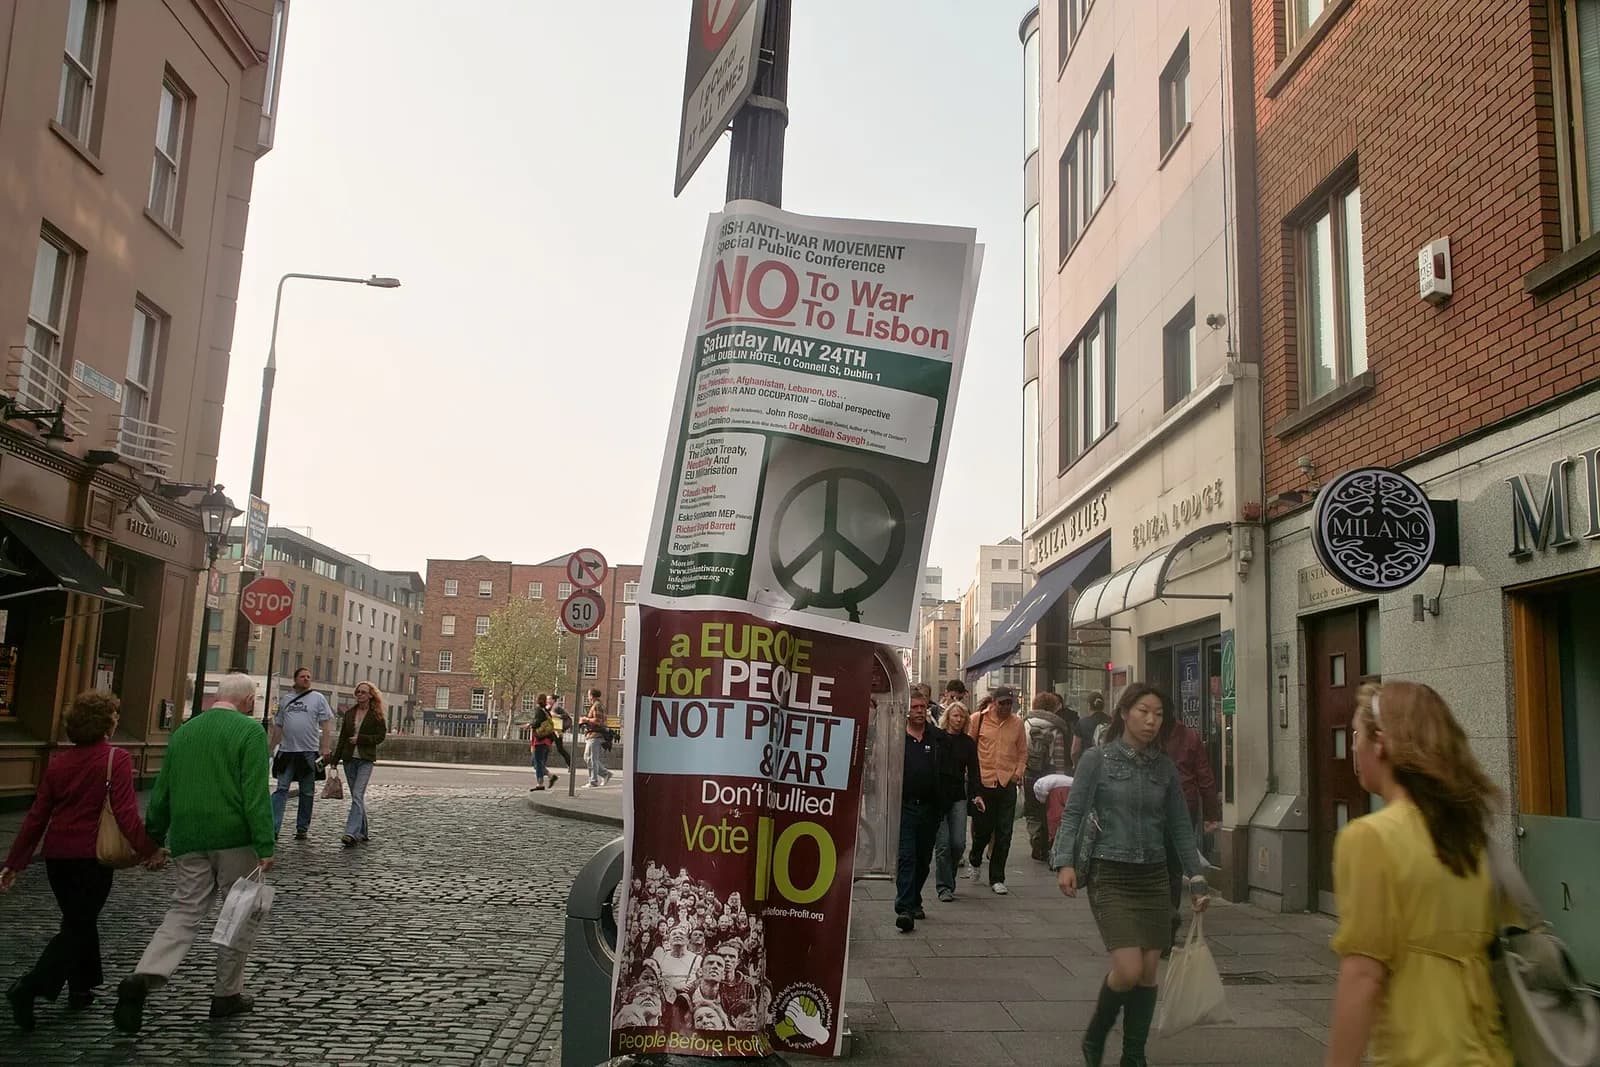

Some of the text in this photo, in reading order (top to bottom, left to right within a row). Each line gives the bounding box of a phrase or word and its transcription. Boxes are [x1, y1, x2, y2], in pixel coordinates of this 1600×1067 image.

[686, 55, 745, 156] AT ALL TIMES
[747, 221, 818, 251] ANTI-WAR
[822, 239, 906, 261] MOVEMENT
[757, 238, 801, 260] Public
[804, 250, 886, 274] Conference
[706, 254, 800, 322] NO
[805, 271, 914, 313] To War
[801, 299, 949, 350] To Lisbon
[703, 330, 867, 368] Saturday MAY 24TH
[717, 350, 747, 361] DUBLIN
[749, 351, 781, 366] HOTEL,
[792, 357, 827, 373] Connell
[843, 364, 873, 381] Dublin
[875, 371, 881, 382] 1
[736, 375, 786, 390] Afghanistan,
[787, 383, 825, 397] Lebanon,
[721, 386, 738, 395] WAR
[739, 386, 757, 396] AND
[758, 387, 809, 404] OCCUPATION
[818, 398, 844, 410] Global
[844, 403, 891, 420] perspective
[766, 407, 786, 418] John
[787, 409, 808, 420] Rose
[788, 421, 799, 430] Dr
[800, 423, 835, 438] Abdullah
[836, 431, 866, 446] Sayegh
[713, 455, 730, 465] And
[719, 445, 748, 457] Treaty,
[709, 520, 736, 531] Barrett
[718, 509, 736, 518] MEP
[1038, 493, 1107, 563] ELIZA BLUES
[1132, 477, 1224, 551] ELIZA LODGE
[1332, 517, 1425, 540] MILANO
[128, 518, 179, 547] FITZSIMONS
[244, 590, 292, 612] STOP
[572, 603, 591, 620] 50
[670, 633, 691, 658] a
[656, 658, 712, 696] for
[649, 701, 735, 739] NOT
[701, 780, 764, 807] Don't
[681, 814, 838, 905] Vote 10
[618, 1031, 667, 1054] People
[669, 1031, 724, 1052] Before
